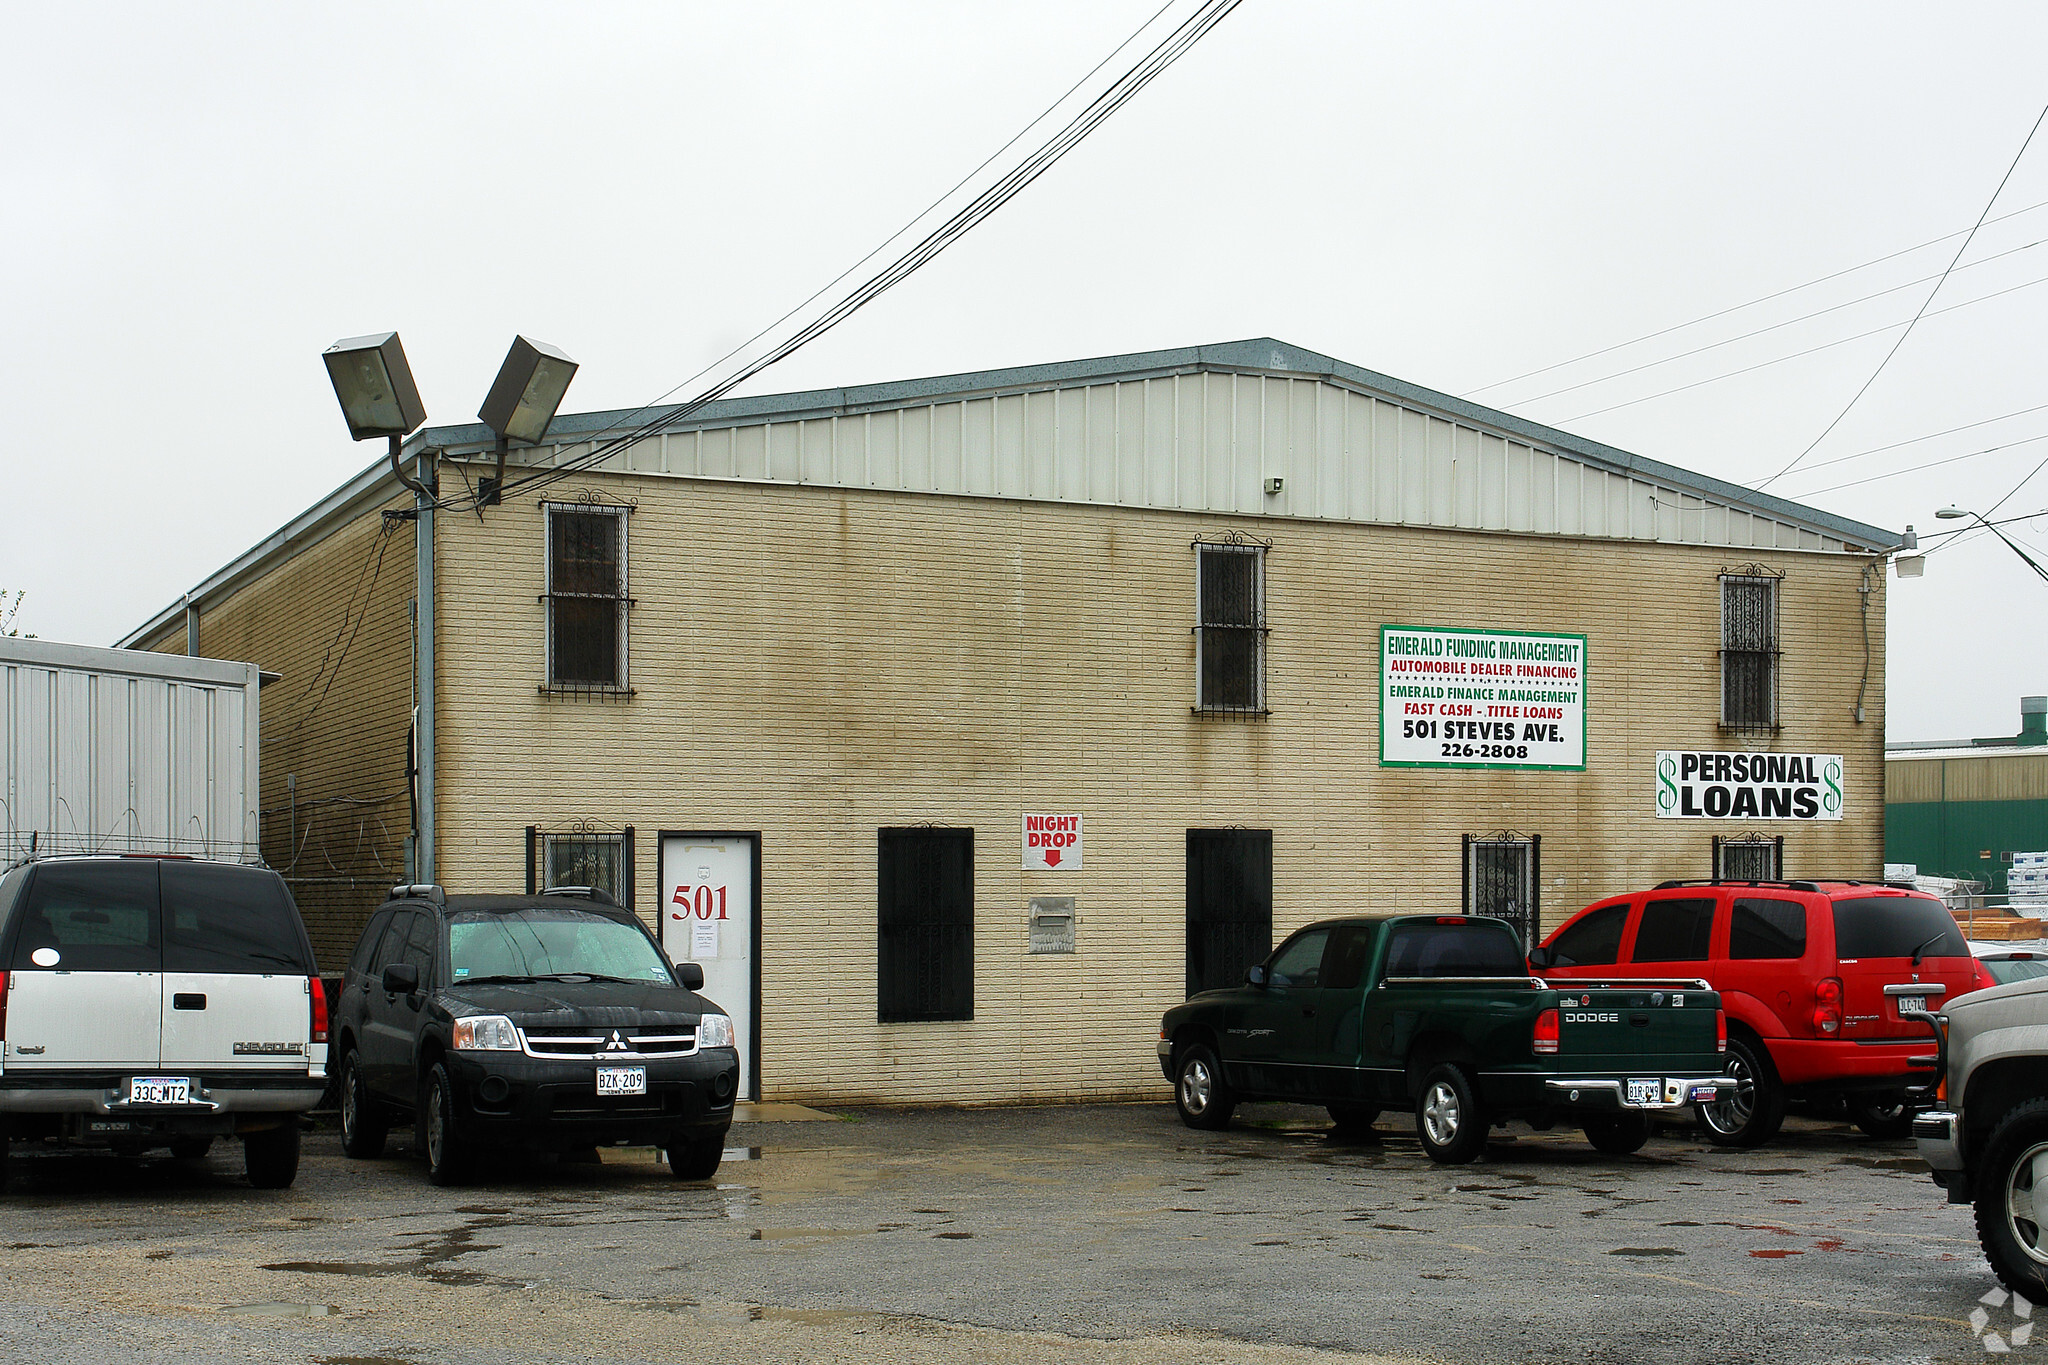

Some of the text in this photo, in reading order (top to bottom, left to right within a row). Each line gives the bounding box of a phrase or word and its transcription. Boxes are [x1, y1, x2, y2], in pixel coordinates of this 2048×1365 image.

[1388, 636, 1579, 662] EMERALD FUNDING MANAGEMENT
[1391, 660, 1577, 679] AUTOMOBILE DEALER FINANCING
[1389, 685, 1577, 703] EMERALD FINANCE MANAGEMENT
[1404, 703, 1435, 716] FAST
[1439, 704, 1473, 717] CASH
[1487, 705, 1519, 718] TITLE
[1523, 706, 1563, 719] LOANS
[1403, 720, 1565, 743] 501 STEVES AVE.
[1441, 743, 1528, 759] 226-2808
[1681, 754, 1819, 783] PERSONAL
[1681, 785, 1819, 818] LOANS
[1026, 816, 1078, 831] NIGHT
[1028, 833, 1077, 847] DROP
[671, 885, 730, 920] 501
[1565, 1013, 1619, 1023] DODGE
[233, 1042, 303, 1051] CHEVROLET
